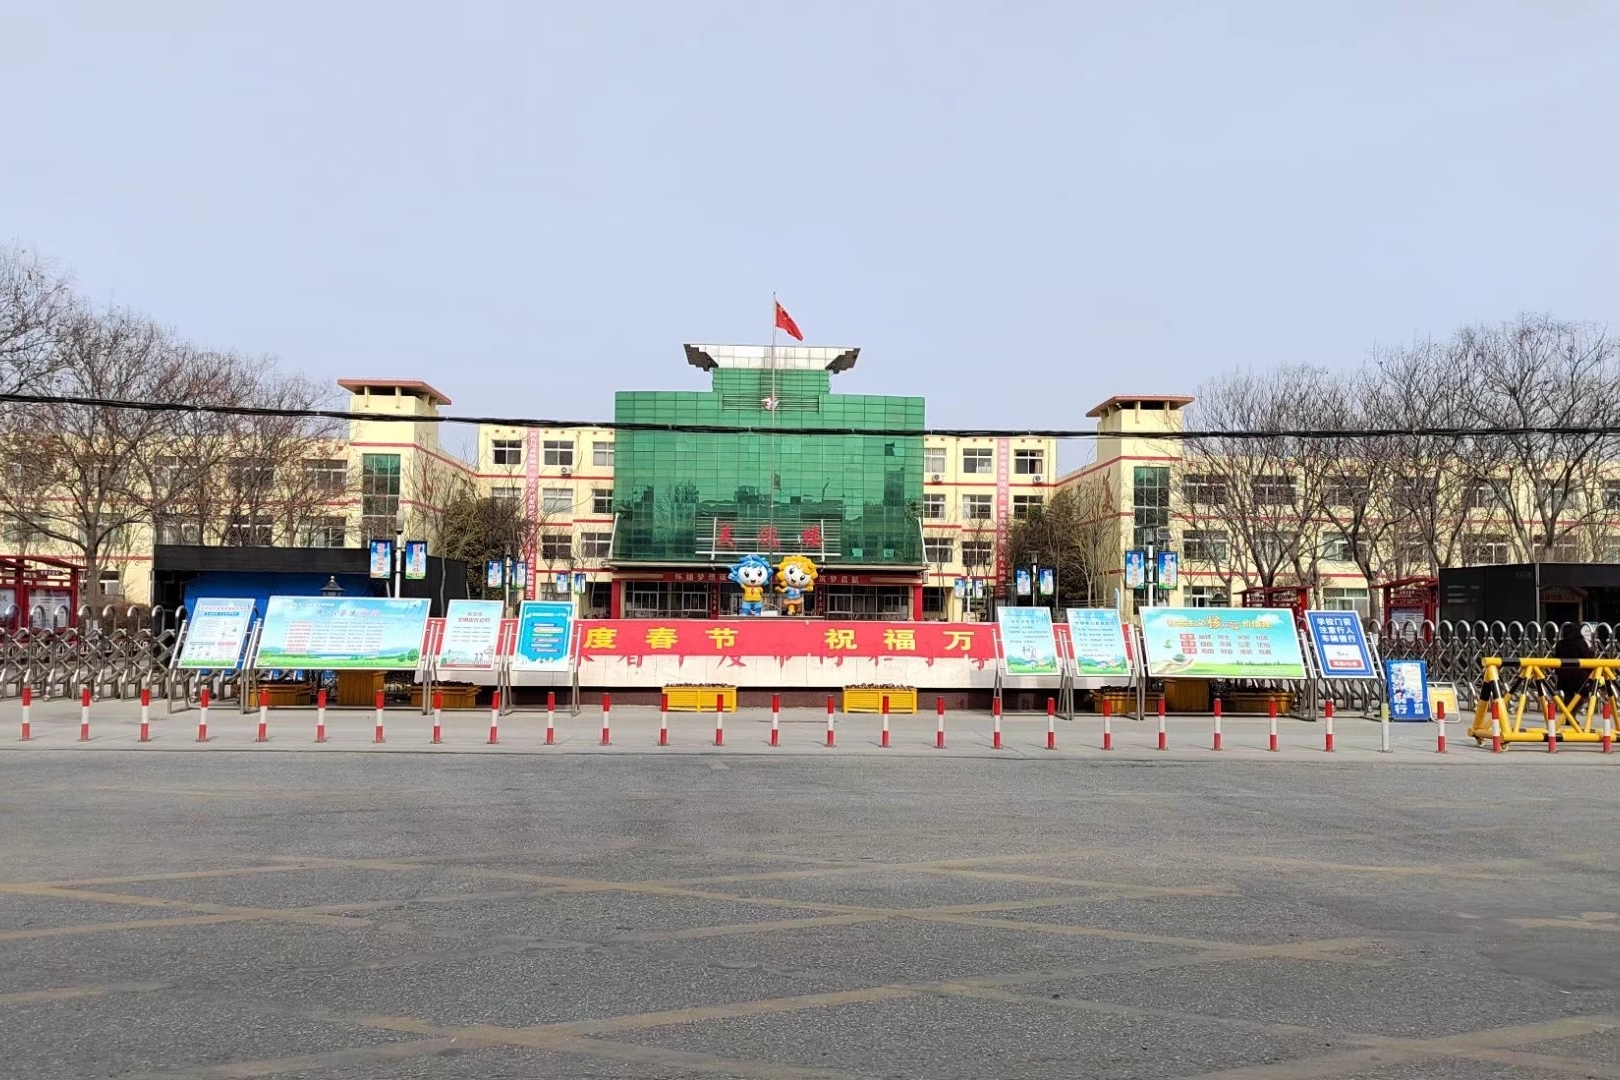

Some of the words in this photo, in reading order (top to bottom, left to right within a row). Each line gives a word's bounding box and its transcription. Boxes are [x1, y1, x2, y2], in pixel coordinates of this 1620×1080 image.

[1316, 617, 1351, 626] 学校门前
[1319, 626, 1355, 634] 注意行人
[583, 627, 740, 649] 度春节
[824, 628, 976, 651] 祝福万
